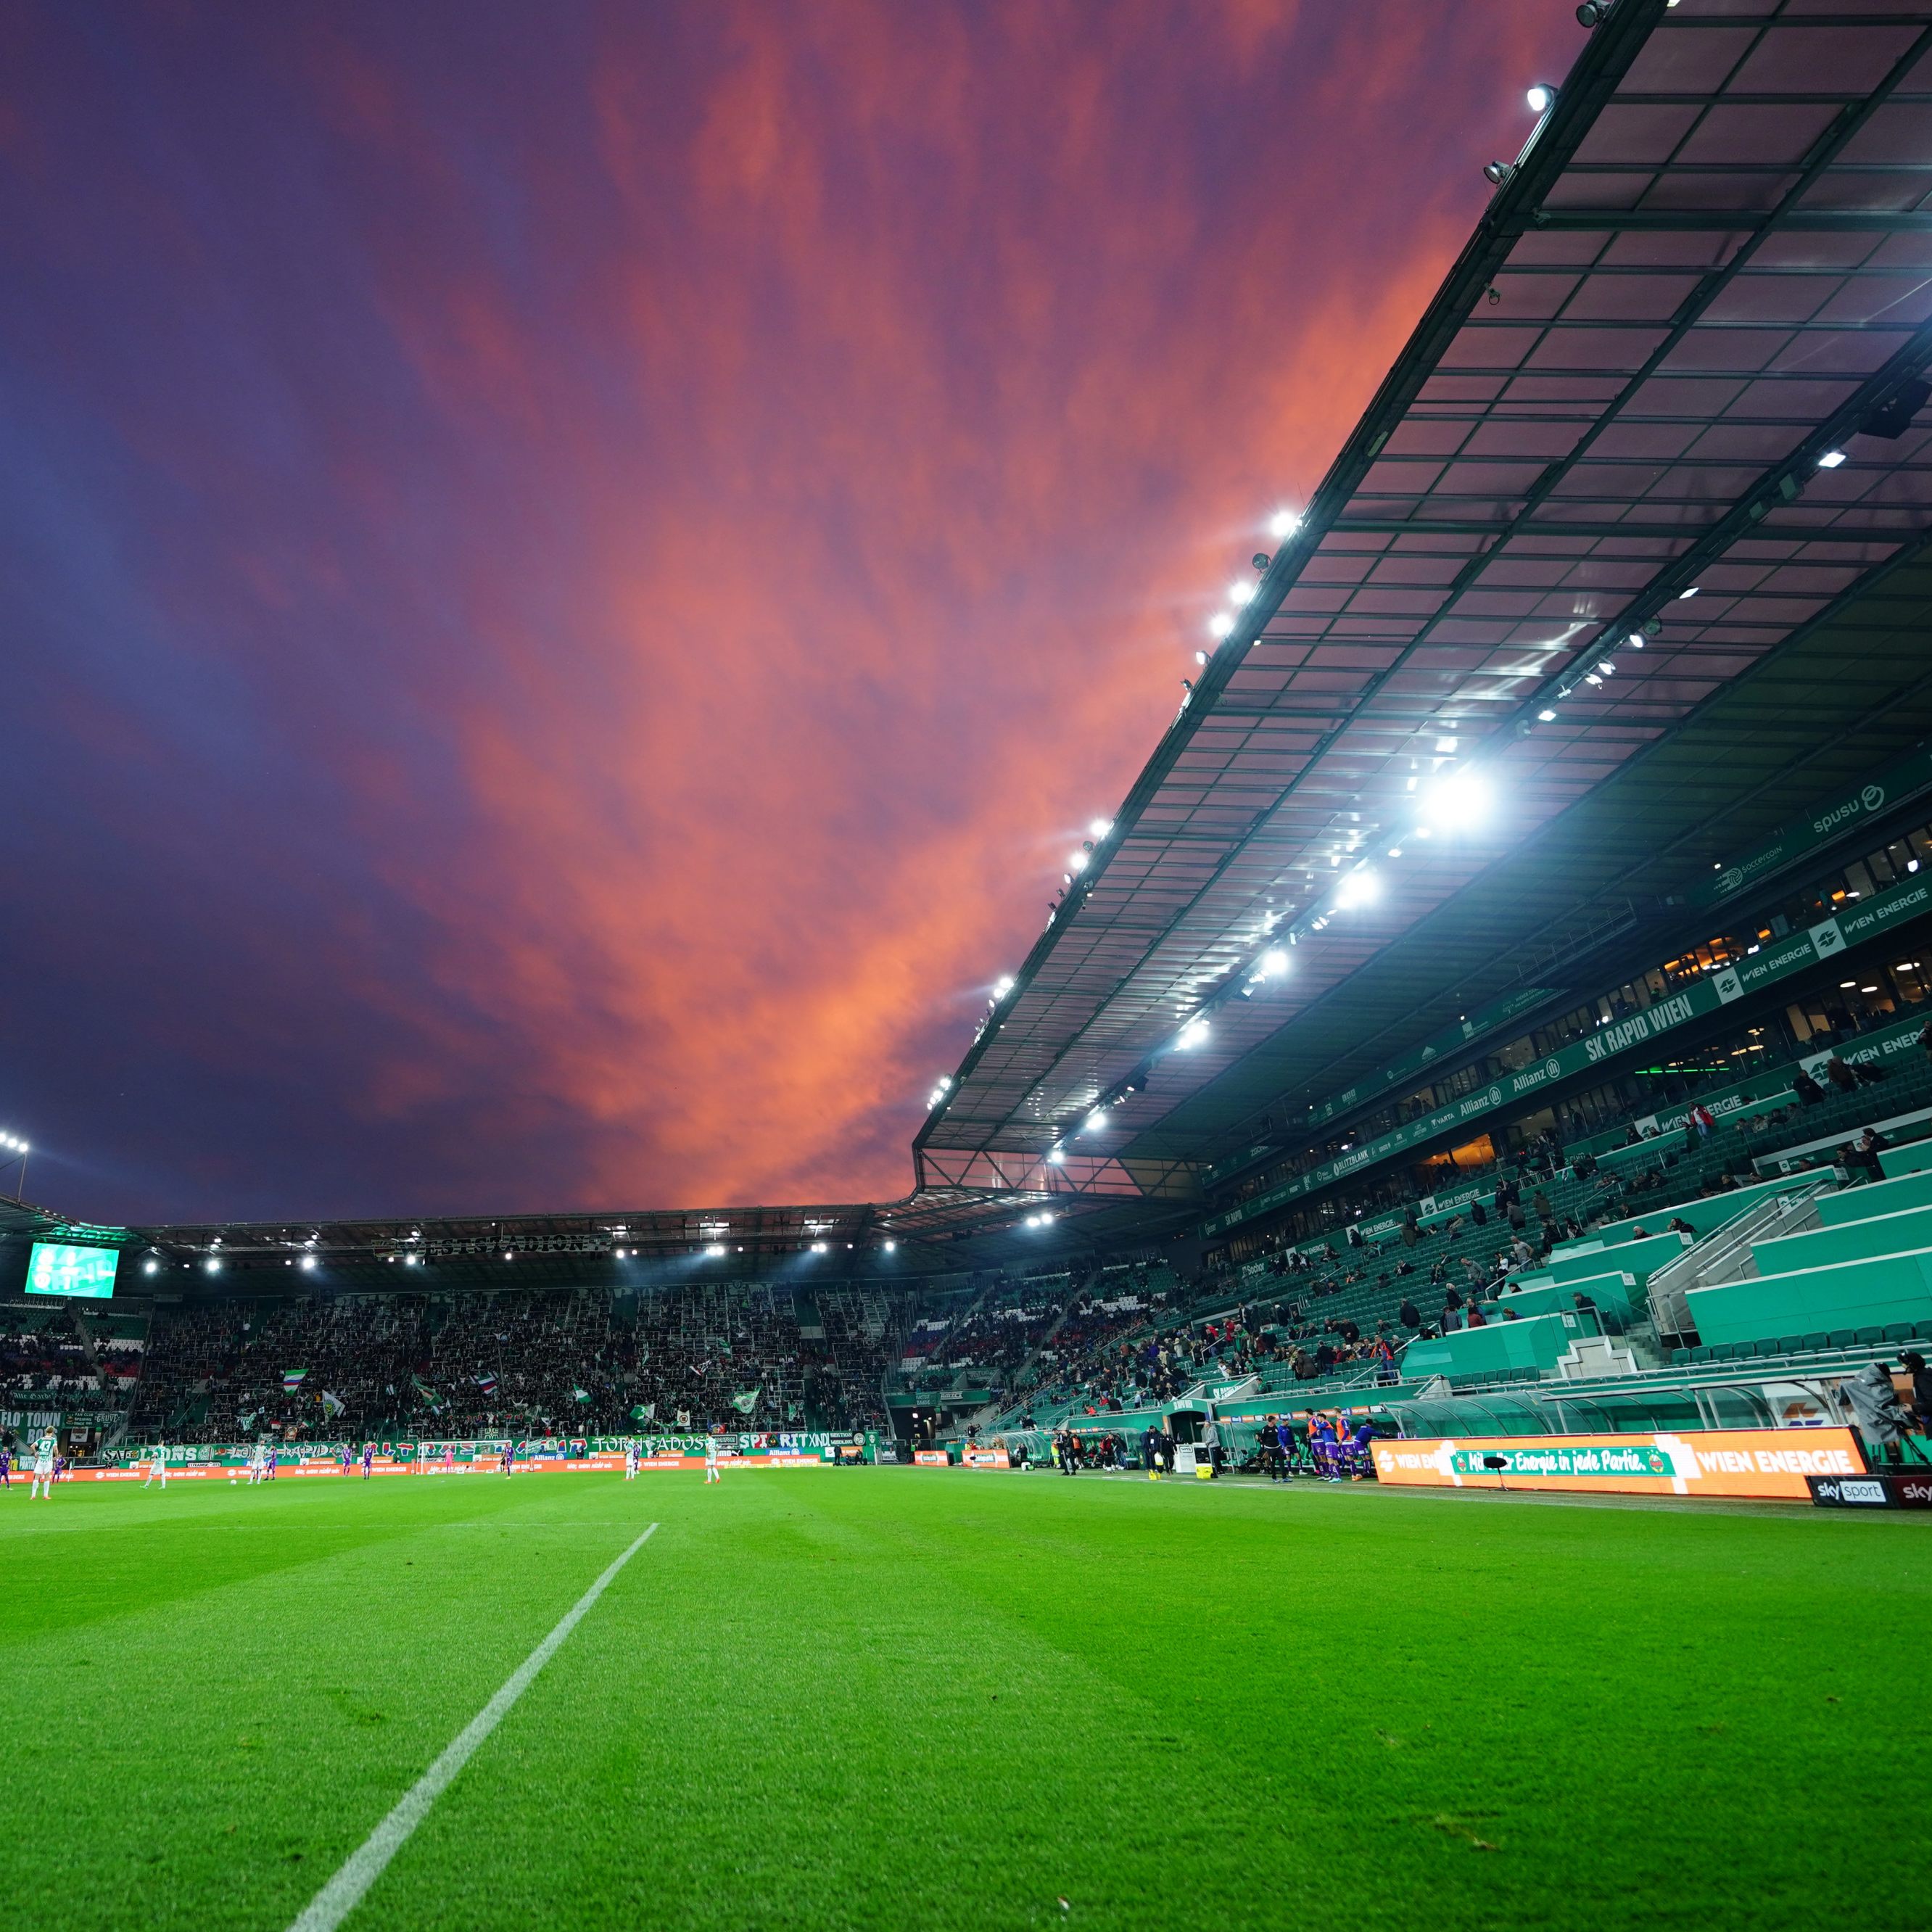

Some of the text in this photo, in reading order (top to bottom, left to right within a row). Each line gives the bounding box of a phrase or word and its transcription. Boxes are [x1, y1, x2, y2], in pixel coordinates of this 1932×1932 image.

[1814, 799, 1859, 833] spusu
[1844, 888, 1928, 935] WIEN ENERGIE
[1742, 944, 1812, 983] WIEN ENERGIE
[1585, 994, 1694, 1062] SK RAPID WIEN
[1513, 1068, 1547, 1092] Allianz
[1460, 1095, 1490, 1117] Allianz
[1437, 1113, 1456, 1126] VARTA
[1338, 1149, 1369, 1171] BLITZBLANK
[1453, 1188, 1481, 1205] ENERGIE
[1374, 1219, 1395, 1232] ENERGIE
[27, 1412, 61, 1427] TOWN
[39, 1440, 51, 1452] 43
[1395, 1453, 1422, 1470] WIEN
[1515, 1451, 1558, 1477] Energie
[1558, 1450, 1571, 1471] in
[1572, 1450, 1600, 1476] jede
[1601, 1448, 1646, 1471] Partie.
[1696, 1450, 1856, 1474] WIEN ENERGIE
[1817, 1482, 1840, 1500] sky
[1844, 1485, 1882, 1499] sport
[1903, 1483, 1932, 1501] sky
